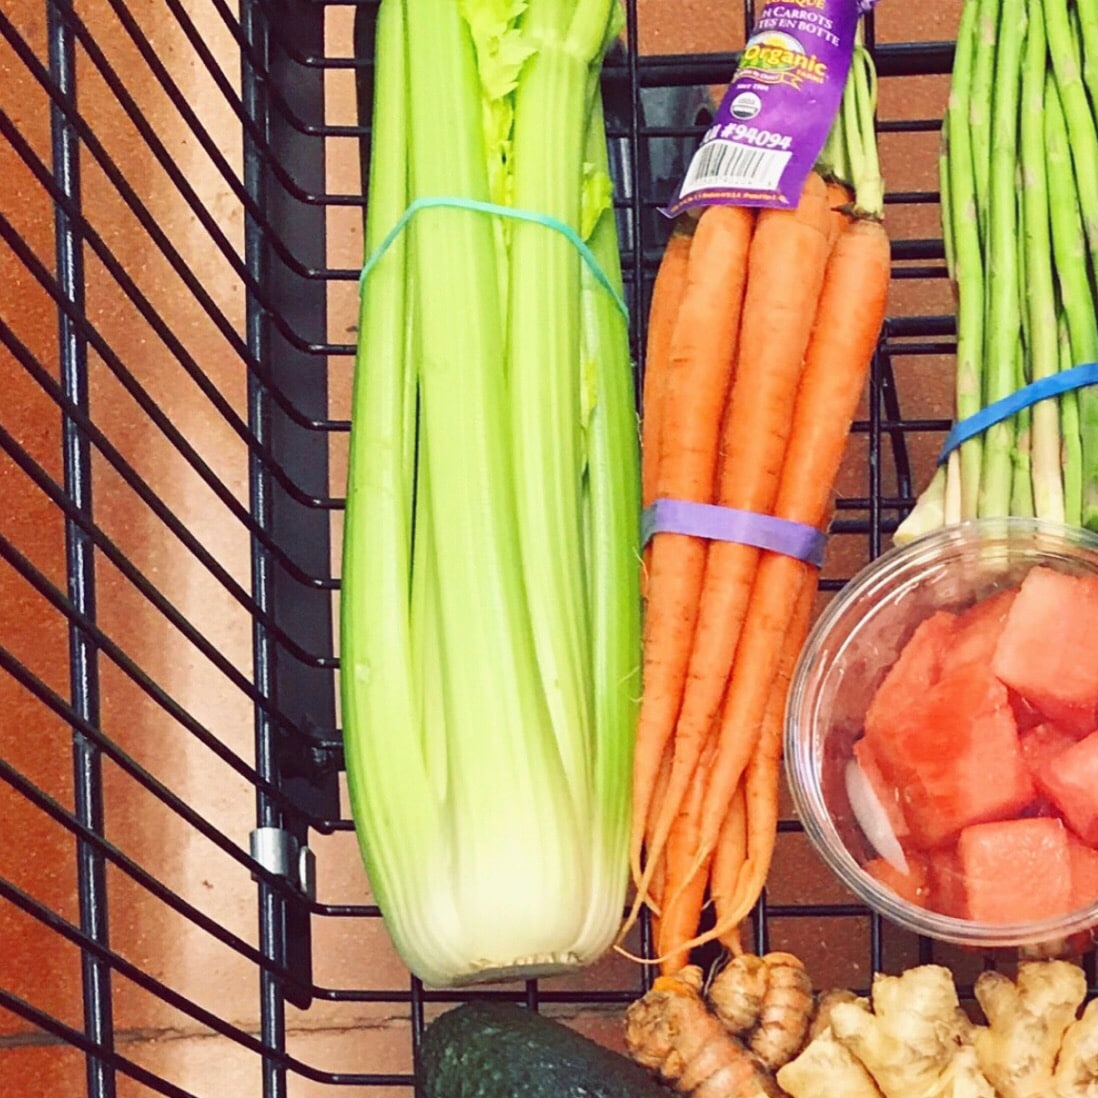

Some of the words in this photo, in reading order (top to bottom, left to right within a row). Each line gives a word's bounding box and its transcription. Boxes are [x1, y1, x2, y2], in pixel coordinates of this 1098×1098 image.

[773, 6, 833, 29] CARROTS
[797, 21, 840, 47] BOTTE
[744, 44, 828, 76] Organic
[720, 122, 793, 150] #94094
